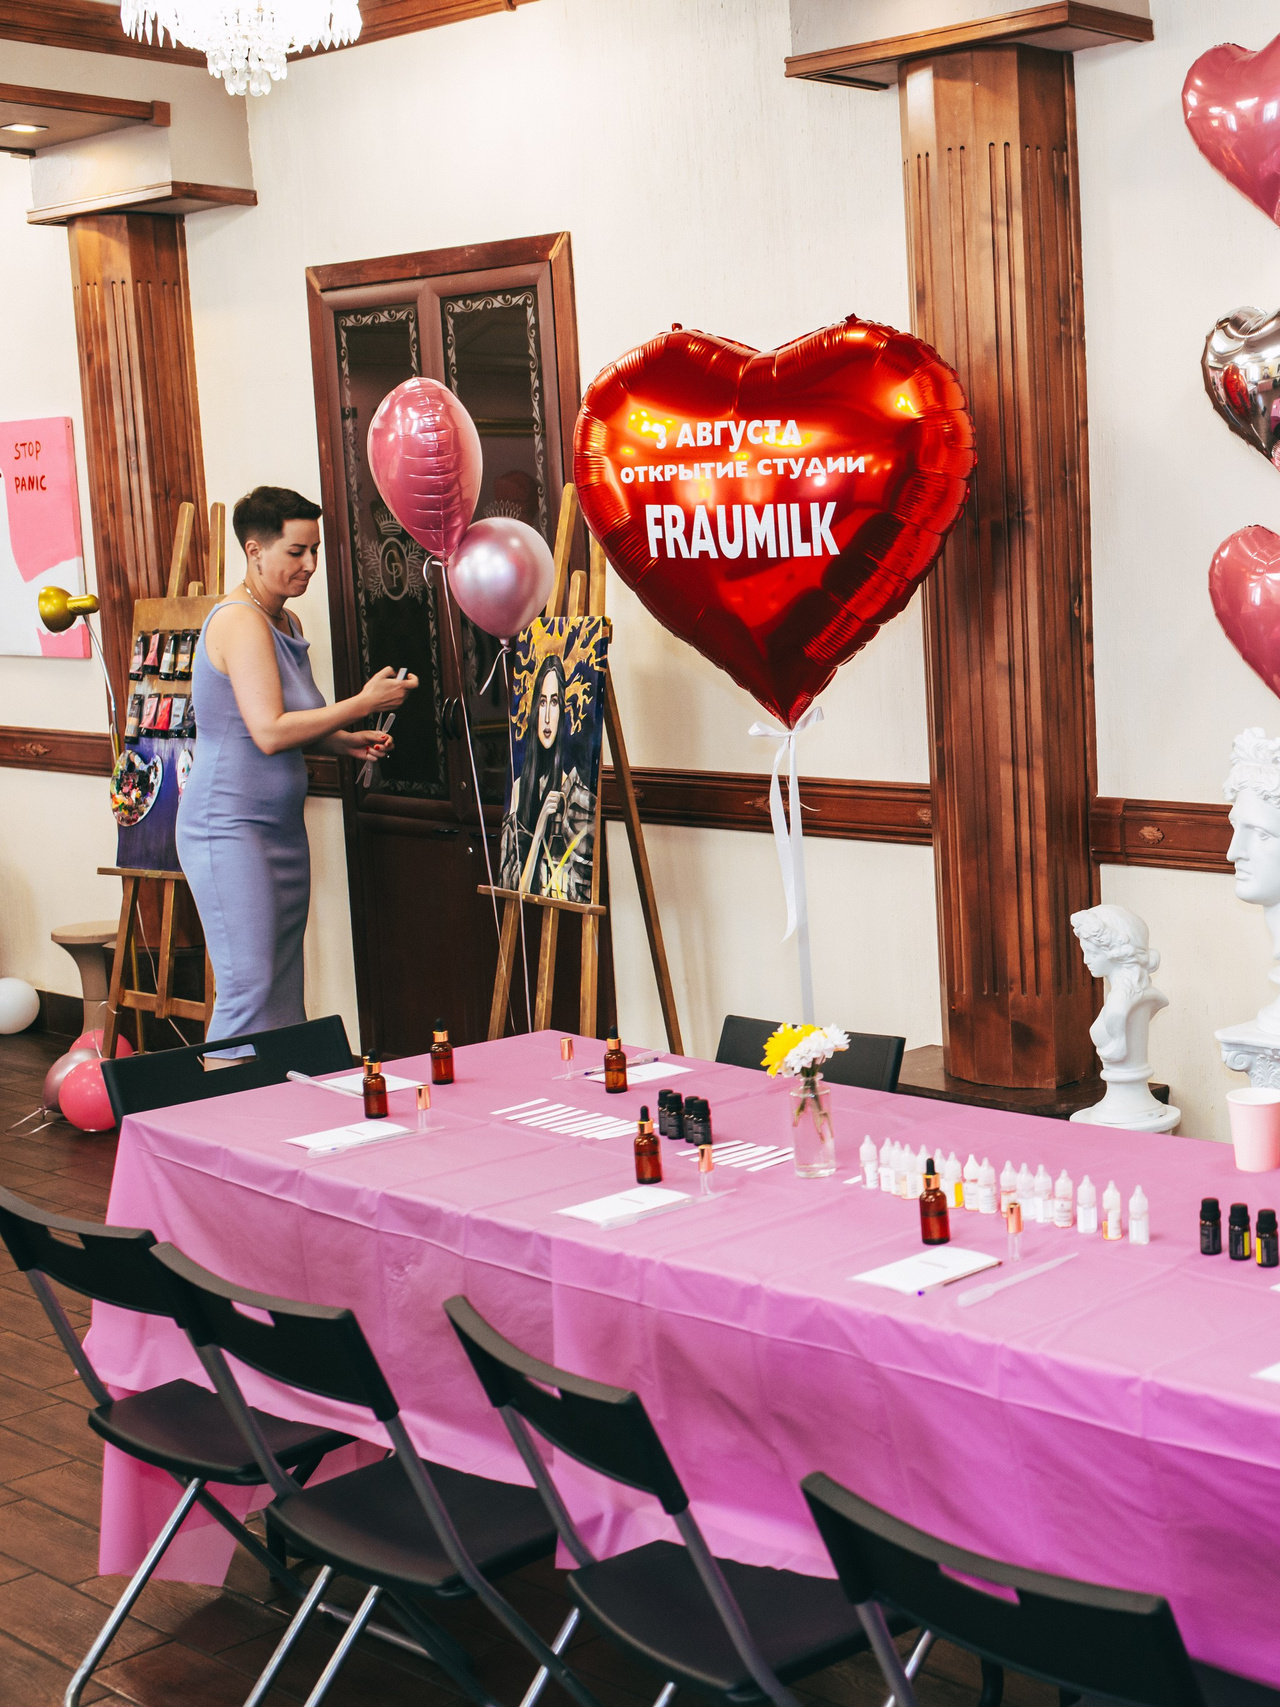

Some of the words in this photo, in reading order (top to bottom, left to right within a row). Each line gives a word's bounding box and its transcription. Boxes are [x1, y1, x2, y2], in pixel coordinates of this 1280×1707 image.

[655, 424, 667, 449] 3
[676, 420, 802, 452] АВГУСТА
[14, 440, 42, 461] STOP
[14, 474, 47, 494] PANIC
[620, 461, 748, 484] ОТКРЫТИЕ
[757, 456, 865, 479] СТУДИИ
[645, 501, 840, 559] FRAUMILK
